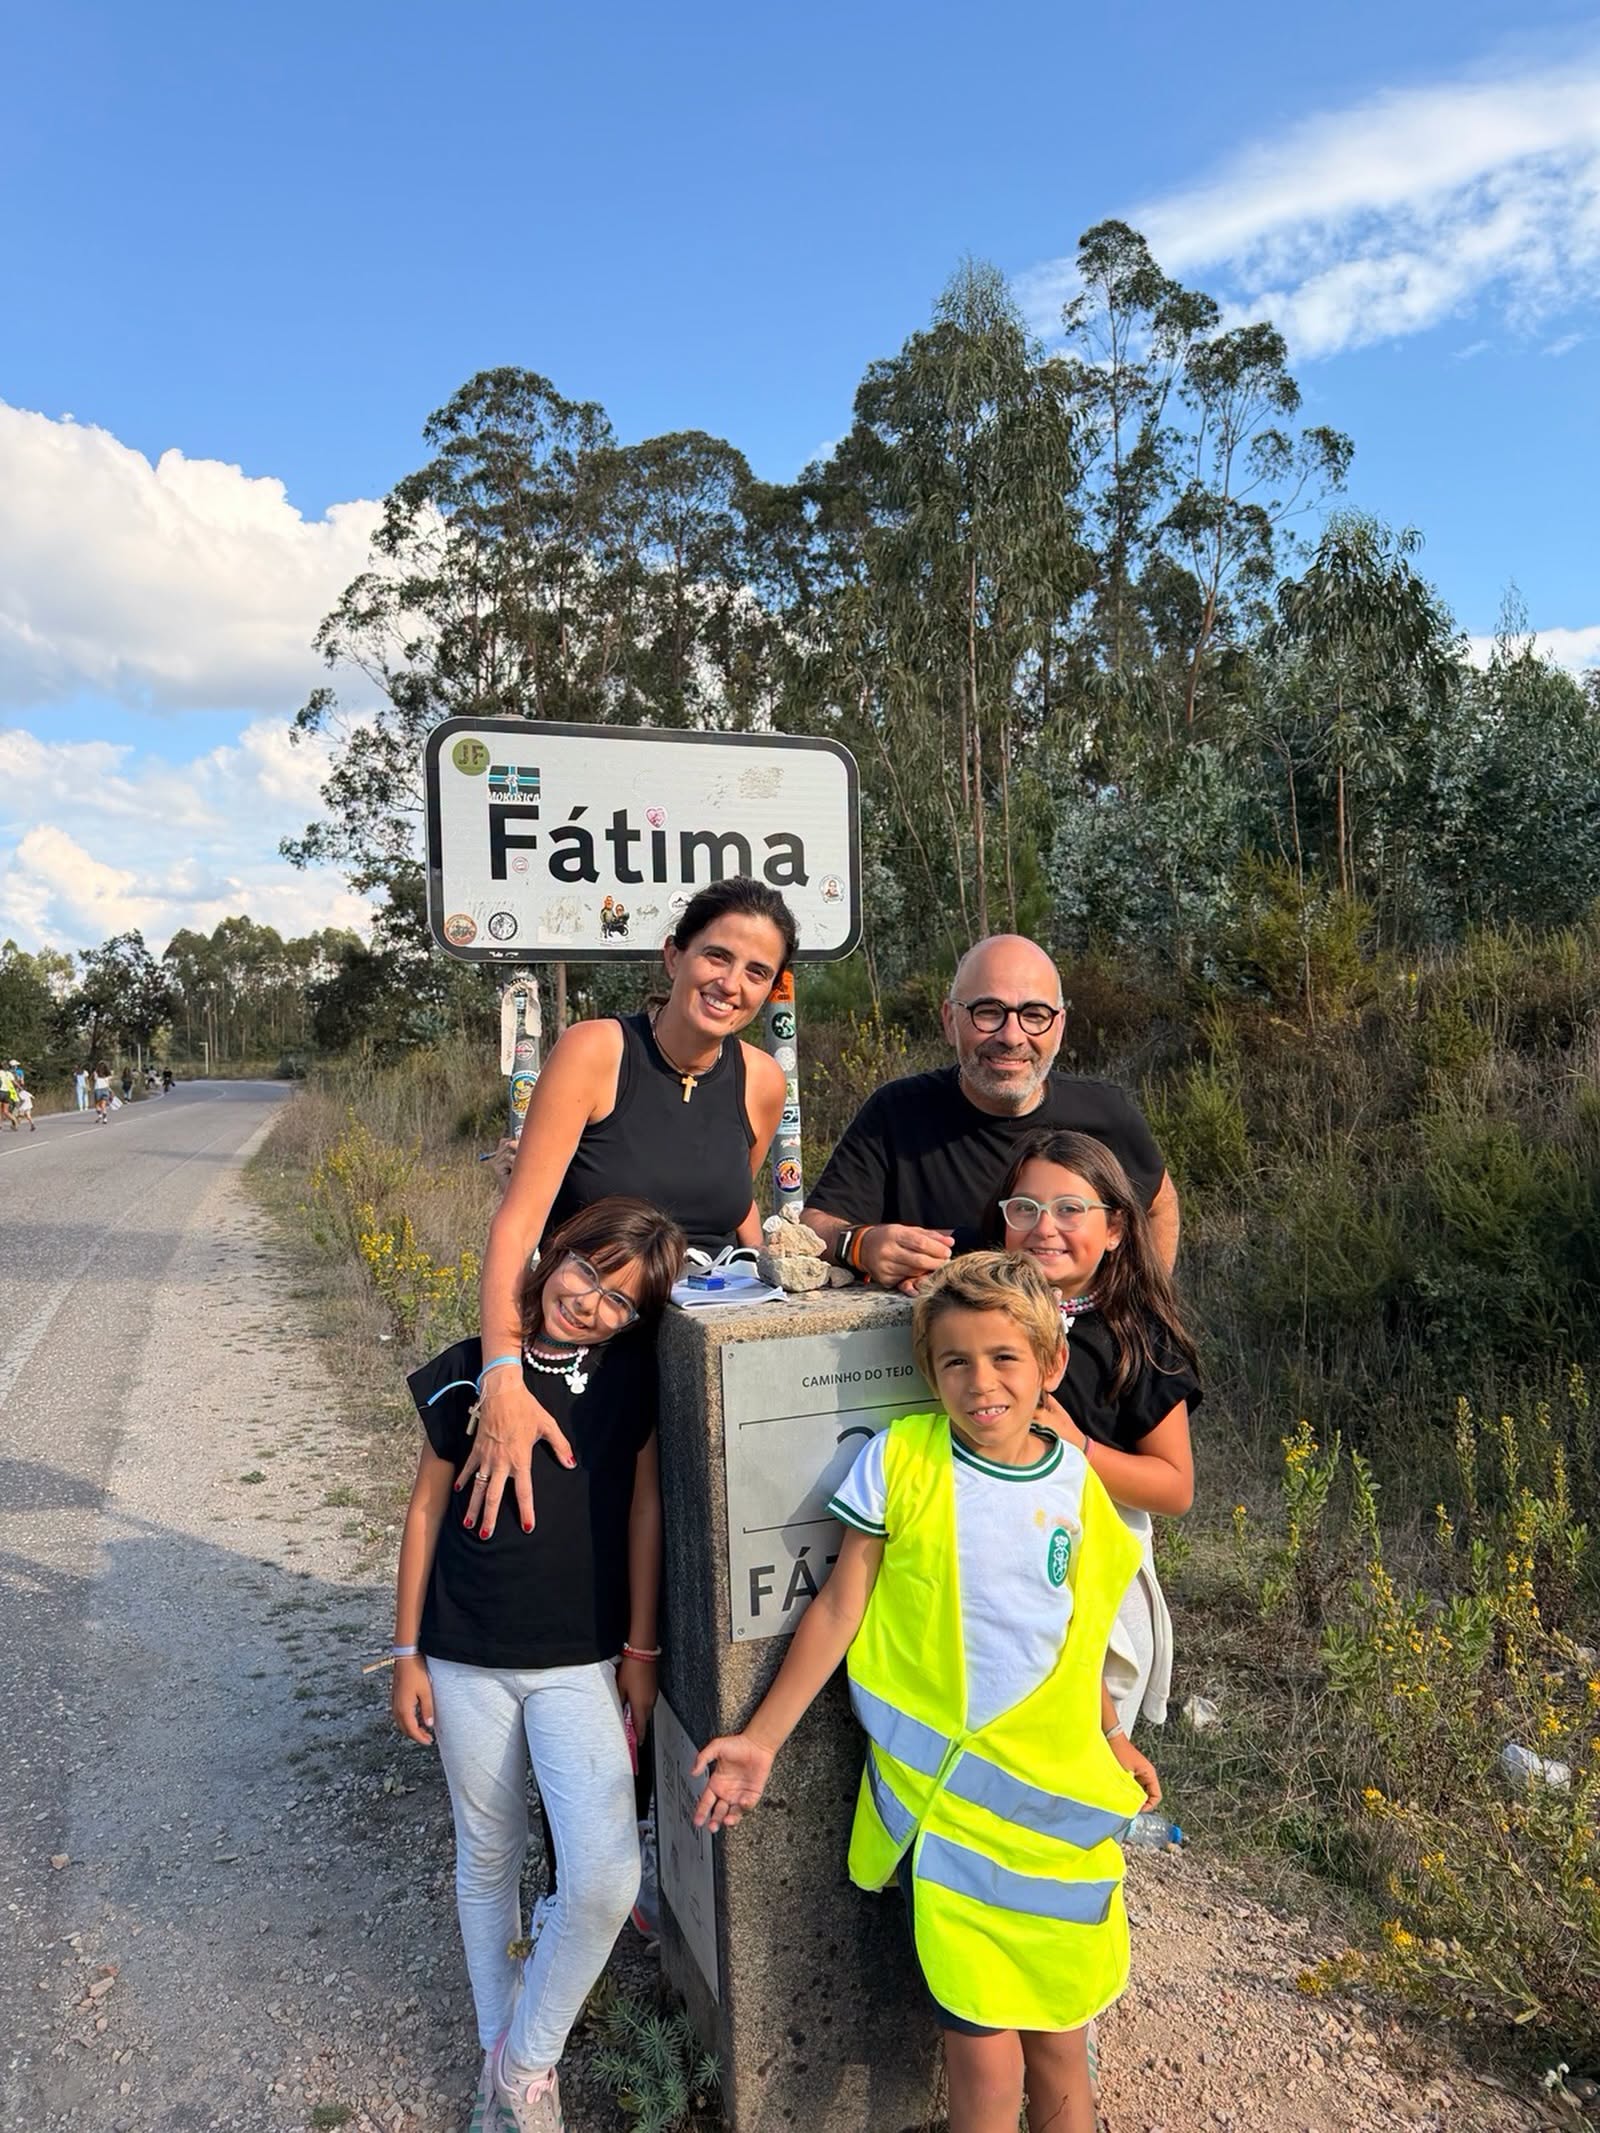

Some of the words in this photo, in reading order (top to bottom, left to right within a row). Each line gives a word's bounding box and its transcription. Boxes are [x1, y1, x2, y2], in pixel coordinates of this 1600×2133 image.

[458, 744, 484, 765] JF
[489, 803, 809, 887] Fátima
[801, 1371, 862, 1388] CAMINHO
[865, 1368, 882, 1381] DO
[885, 1365, 914, 1378] TEJO
